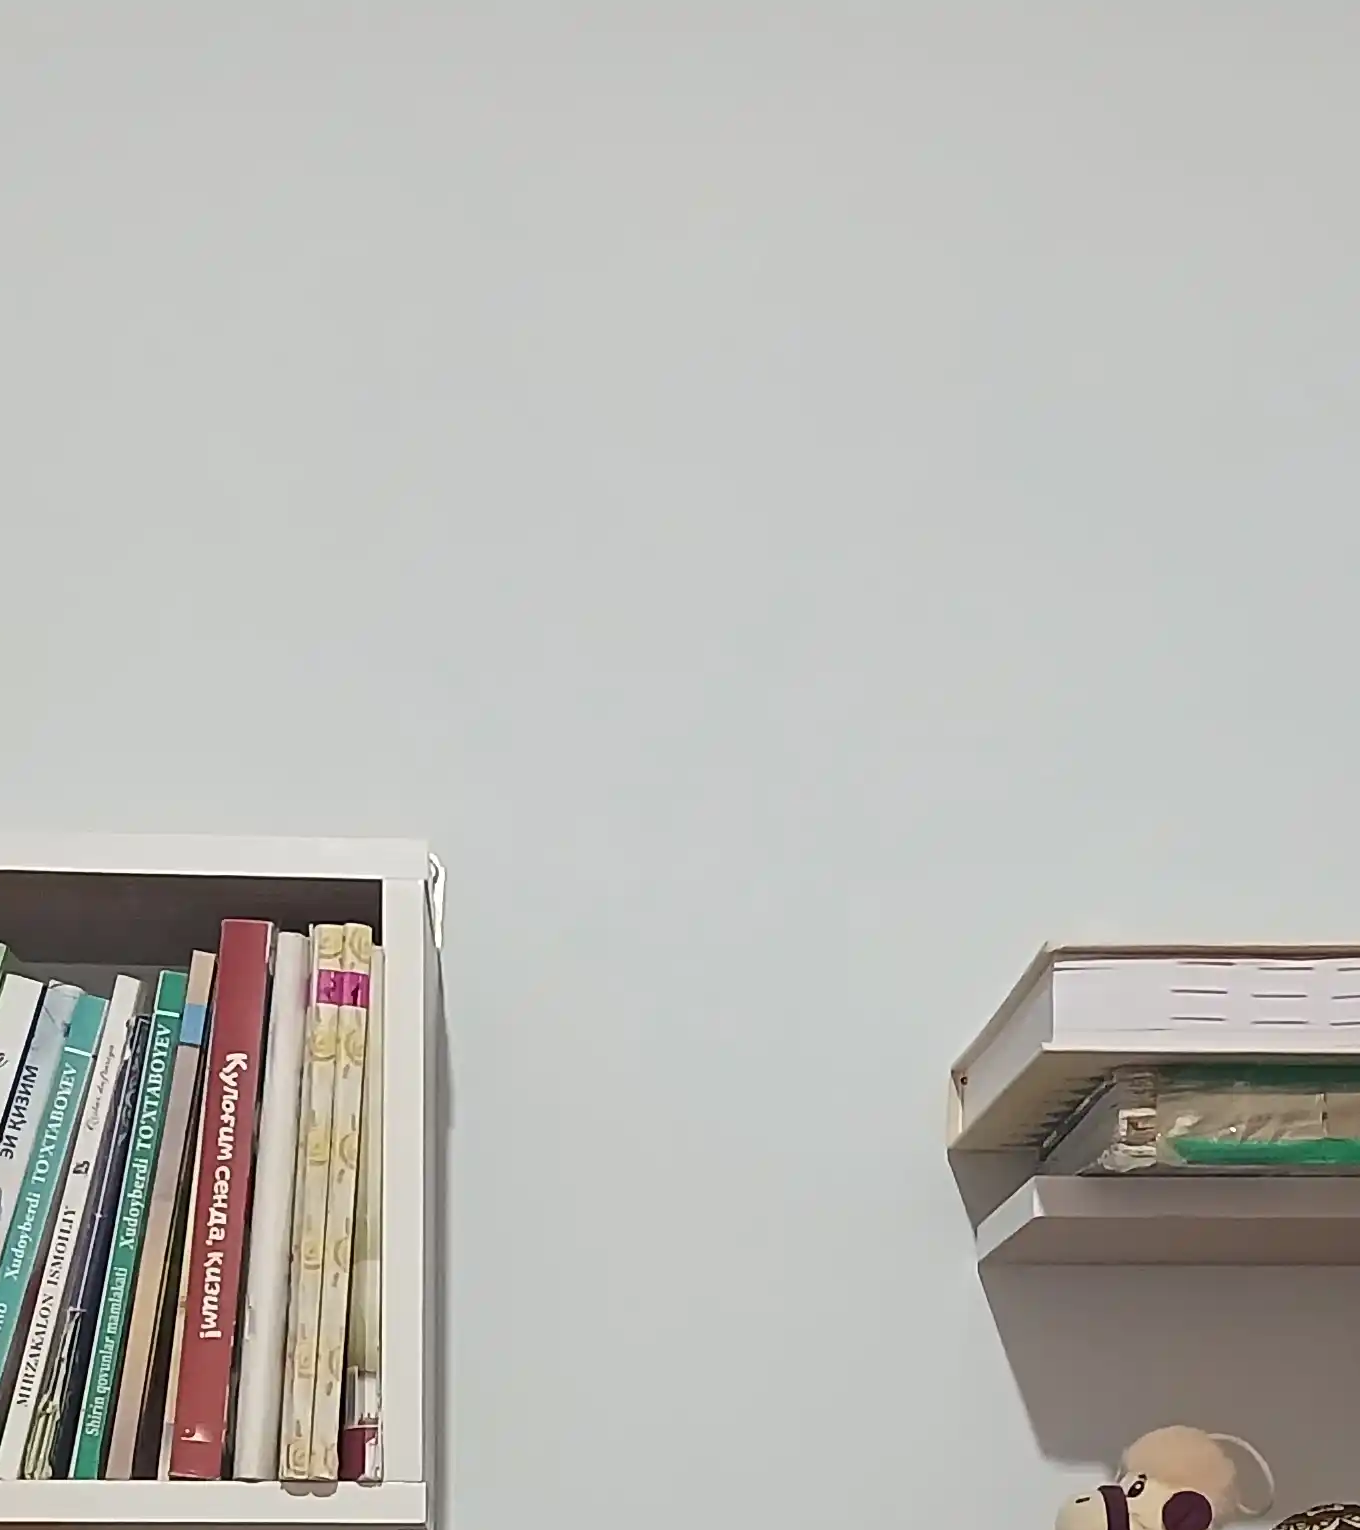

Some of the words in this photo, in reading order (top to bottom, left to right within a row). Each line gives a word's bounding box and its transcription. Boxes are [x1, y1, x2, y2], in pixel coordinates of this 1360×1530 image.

[7, 1064, 39, 1132] ҚИЗИМ
[4, 1190, 41, 1281] Xudoyberdi
[119, 1156, 150, 1250] Xudoyberdi
[205, 1165, 232, 1246] сенда,
[16, 1292, 55, 1408] MIRZAKALON
[47, 1204, 77, 1288] ISMOILIY
[105, 1266, 128, 1335] mamlakati
[95, 1333, 116, 1394] qovunlar
[85, 1395, 105, 1438] Shirin
